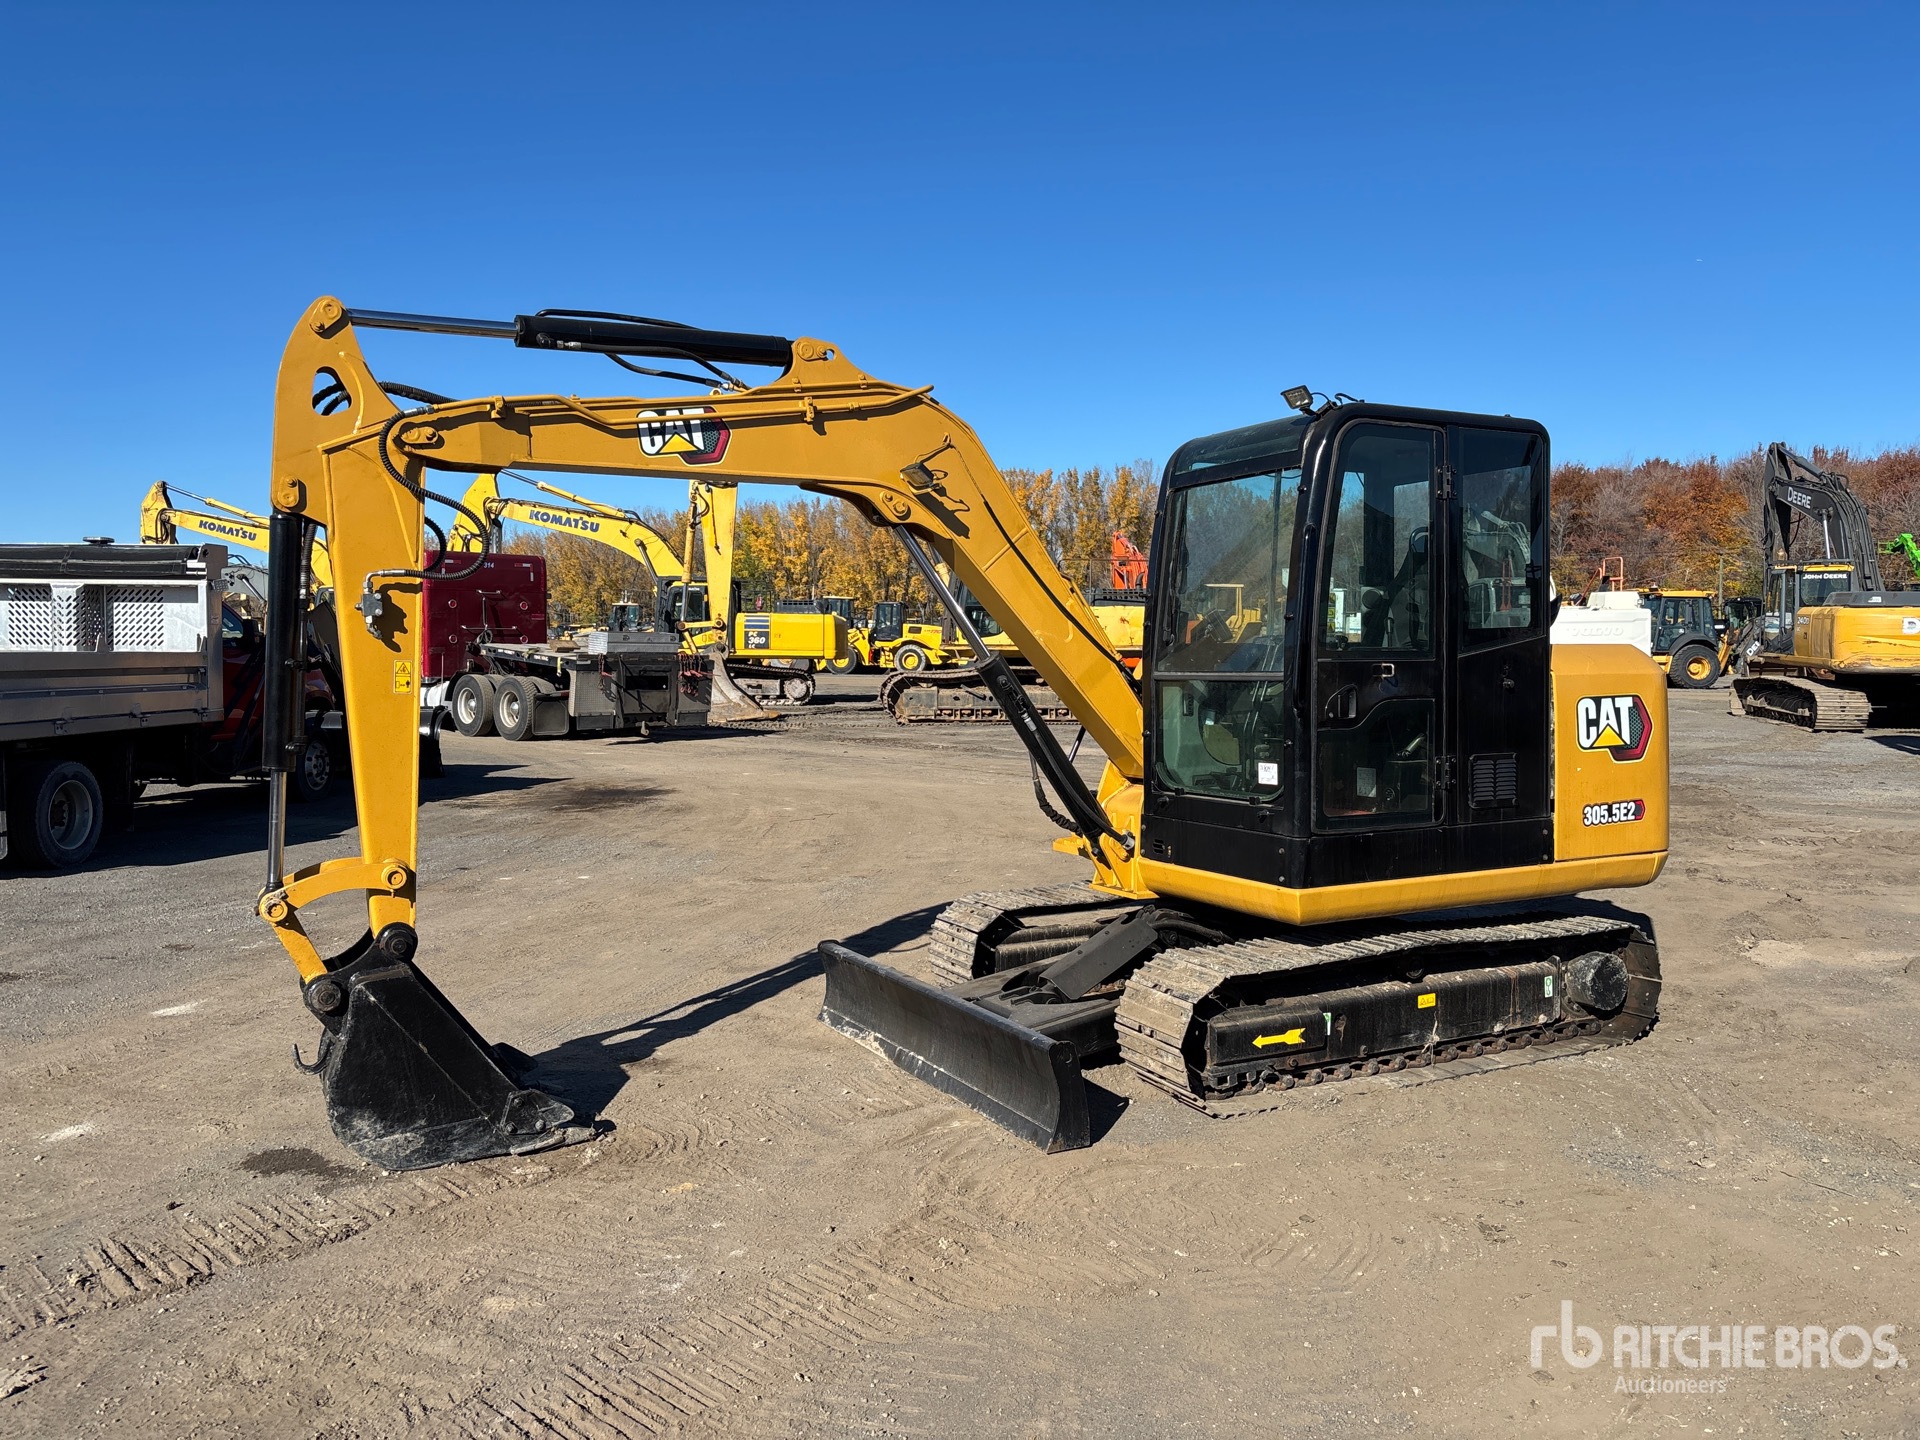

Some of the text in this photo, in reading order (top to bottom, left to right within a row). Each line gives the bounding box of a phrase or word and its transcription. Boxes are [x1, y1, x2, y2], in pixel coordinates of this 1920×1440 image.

[637, 407, 705, 455] CAT
[1788, 487, 1812, 509] DEERE
[198, 519, 257, 541] KOMATSU
[529, 509, 600, 533] KOMATSU
[1577, 697, 1633, 748] CAT
[1583, 802, 1636, 826] 305.5E2
